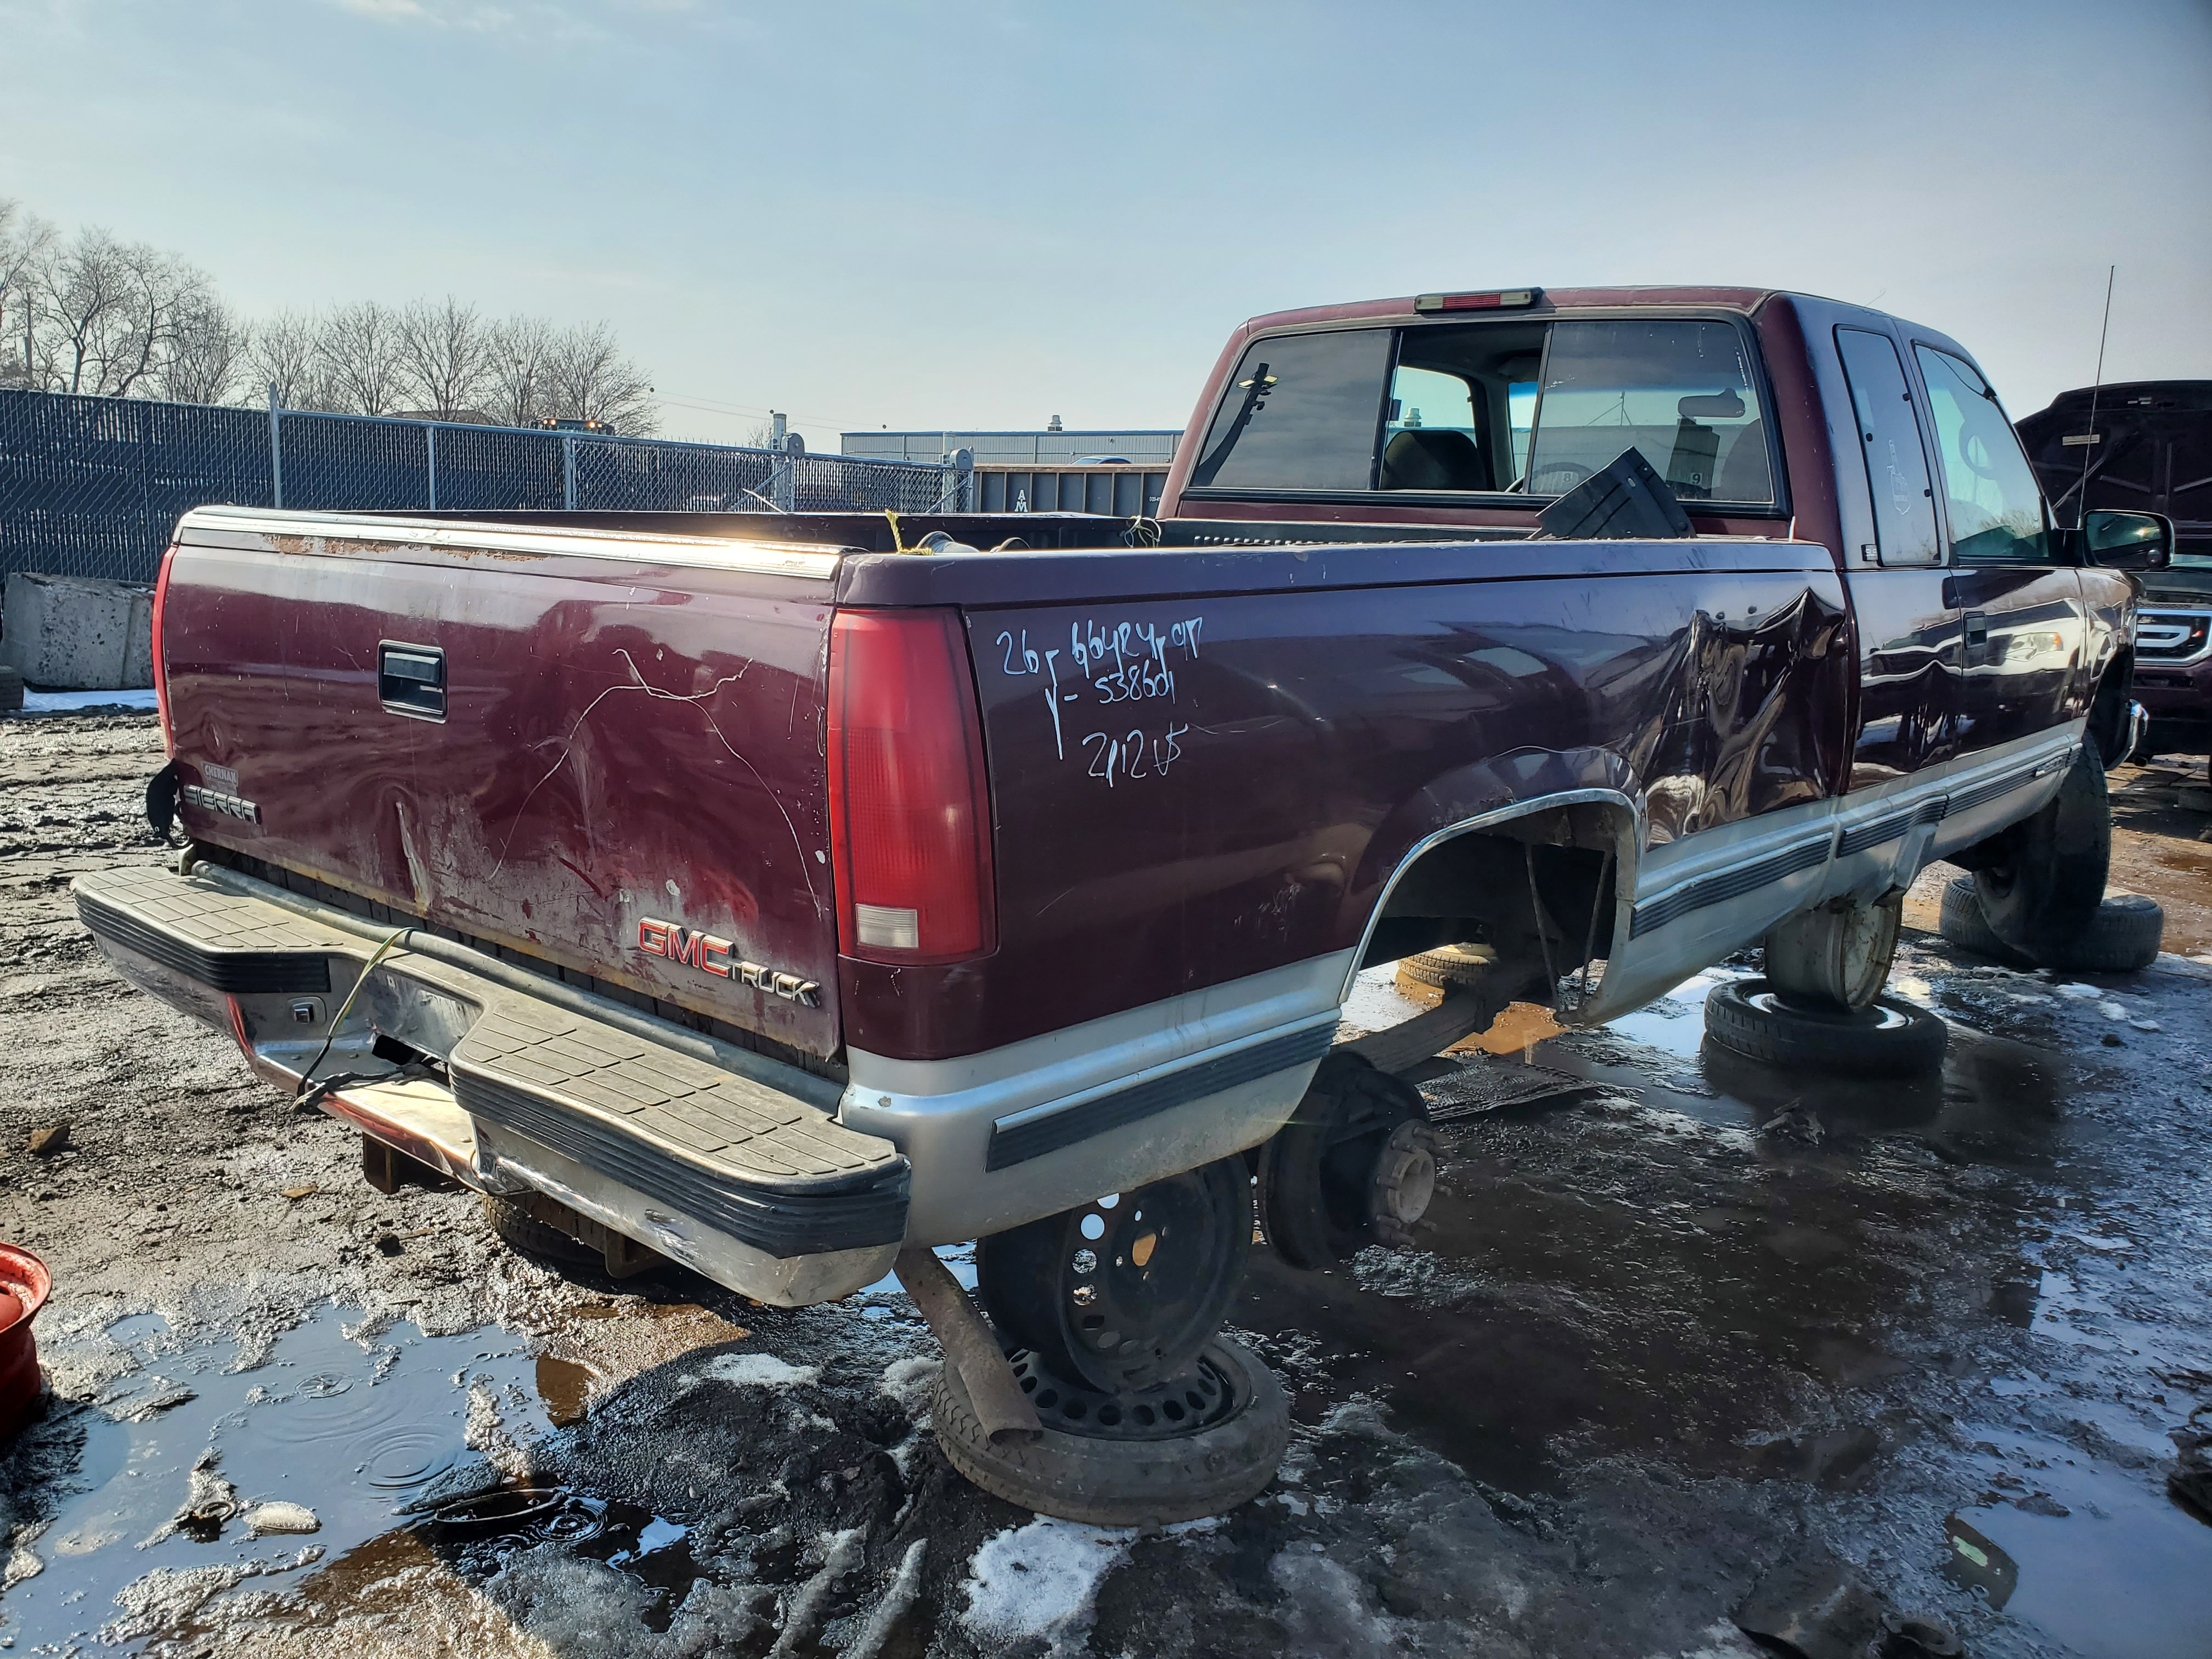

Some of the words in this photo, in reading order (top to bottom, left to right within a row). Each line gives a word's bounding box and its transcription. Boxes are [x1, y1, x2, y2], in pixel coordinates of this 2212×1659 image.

[1692, 473, 1701, 484] 9
[183, 784, 257, 825] SIERRA
[638, 916, 734, 978] GMC
[727, 960, 820, 1008] TRUCK
